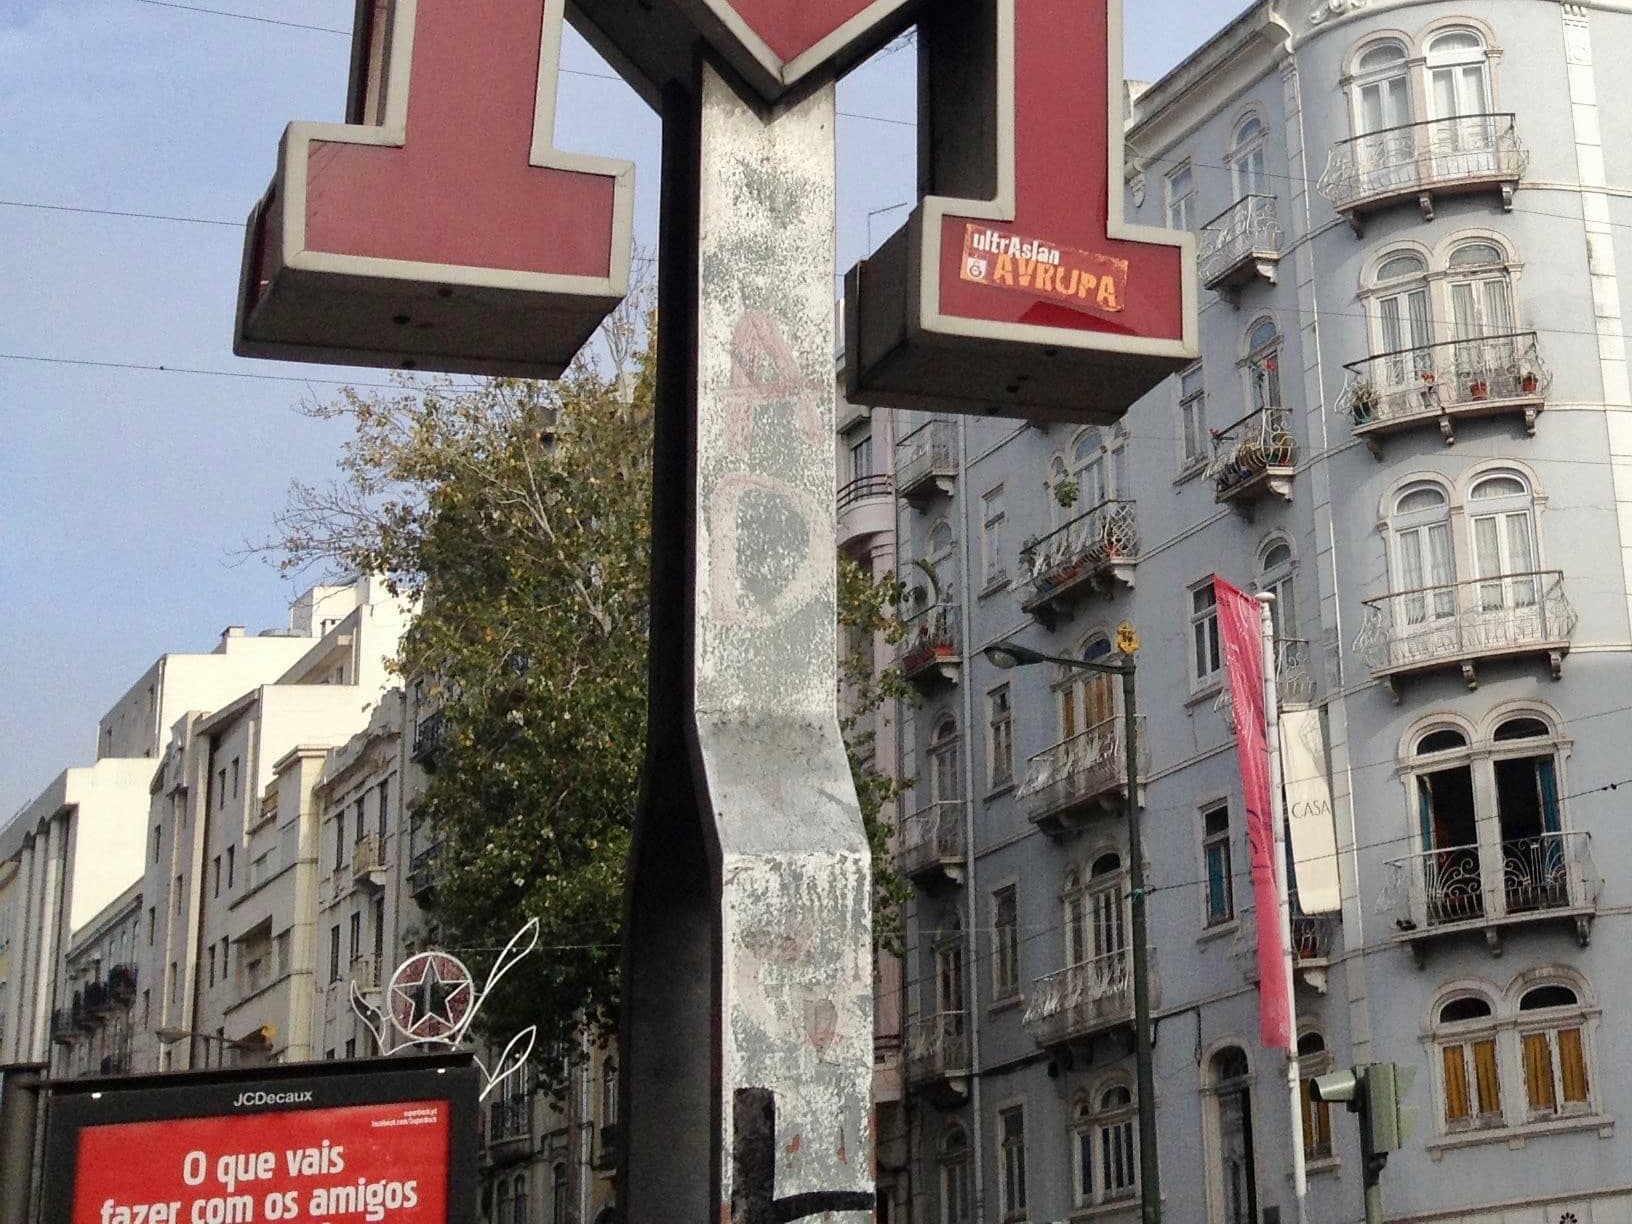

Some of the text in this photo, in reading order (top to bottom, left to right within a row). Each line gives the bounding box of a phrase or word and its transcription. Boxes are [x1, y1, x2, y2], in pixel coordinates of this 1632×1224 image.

[973, 230, 1060, 265] ultrAslan
[993, 254, 1118, 308] AVRUPA
[1292, 799, 1332, 819] CASA
[233, 1091, 313, 1107] JCDecaux
[183, 1139, 345, 1193] O que vais
[100, 1177, 418, 1224] fazer com os amigos
